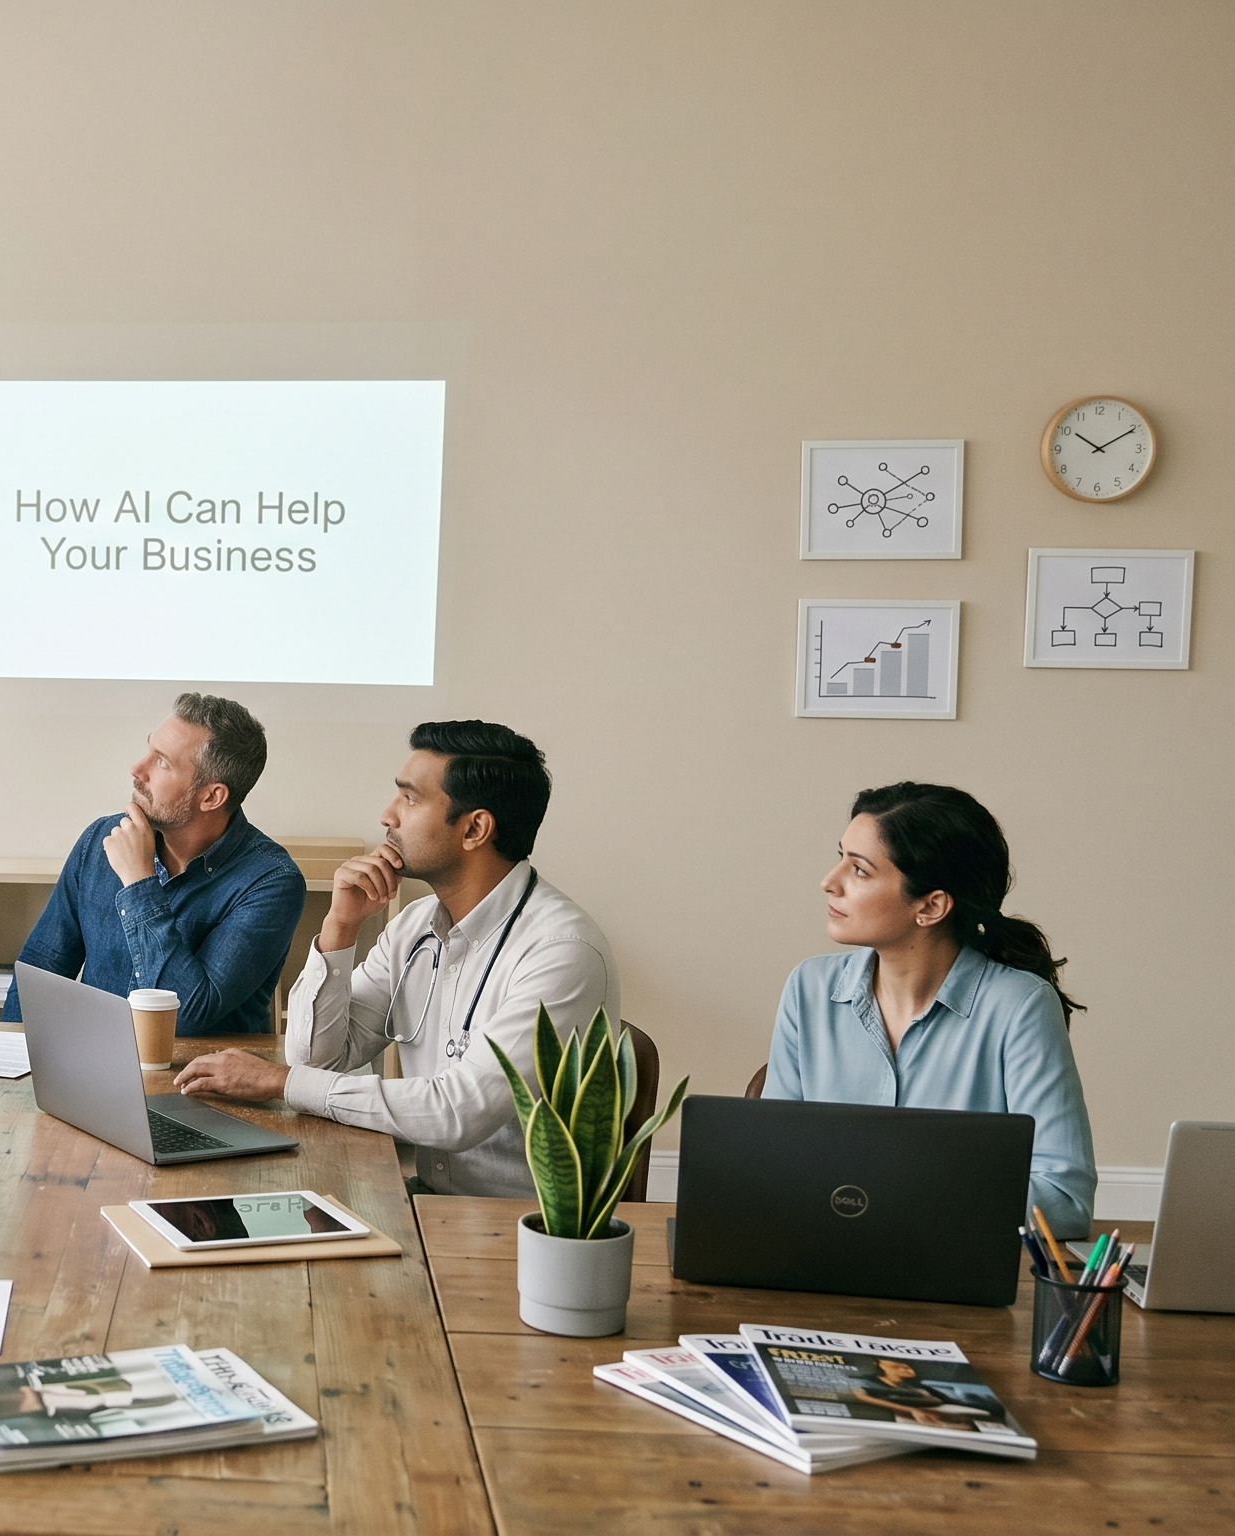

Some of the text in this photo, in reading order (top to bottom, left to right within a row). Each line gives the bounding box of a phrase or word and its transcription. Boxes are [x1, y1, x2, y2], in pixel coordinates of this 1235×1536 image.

[1095, 406, 1105, 415] 12
[1077, 412, 1085, 421] 11
[1061, 426, 1072, 436] 10
[1054, 444, 1062, 454] 9
[1135, 444, 1142, 454] 3
[1060, 464, 1067, 474] 8
[1128, 463, 1135, 472] 4
[1076, 477, 1082, 487] 7
[1093, 482, 1101, 492] 6
[1114, 477, 1121, 487] 5
[15, 489, 346, 534] How AI Can Help
[40, 536, 318, 573] Your Business
